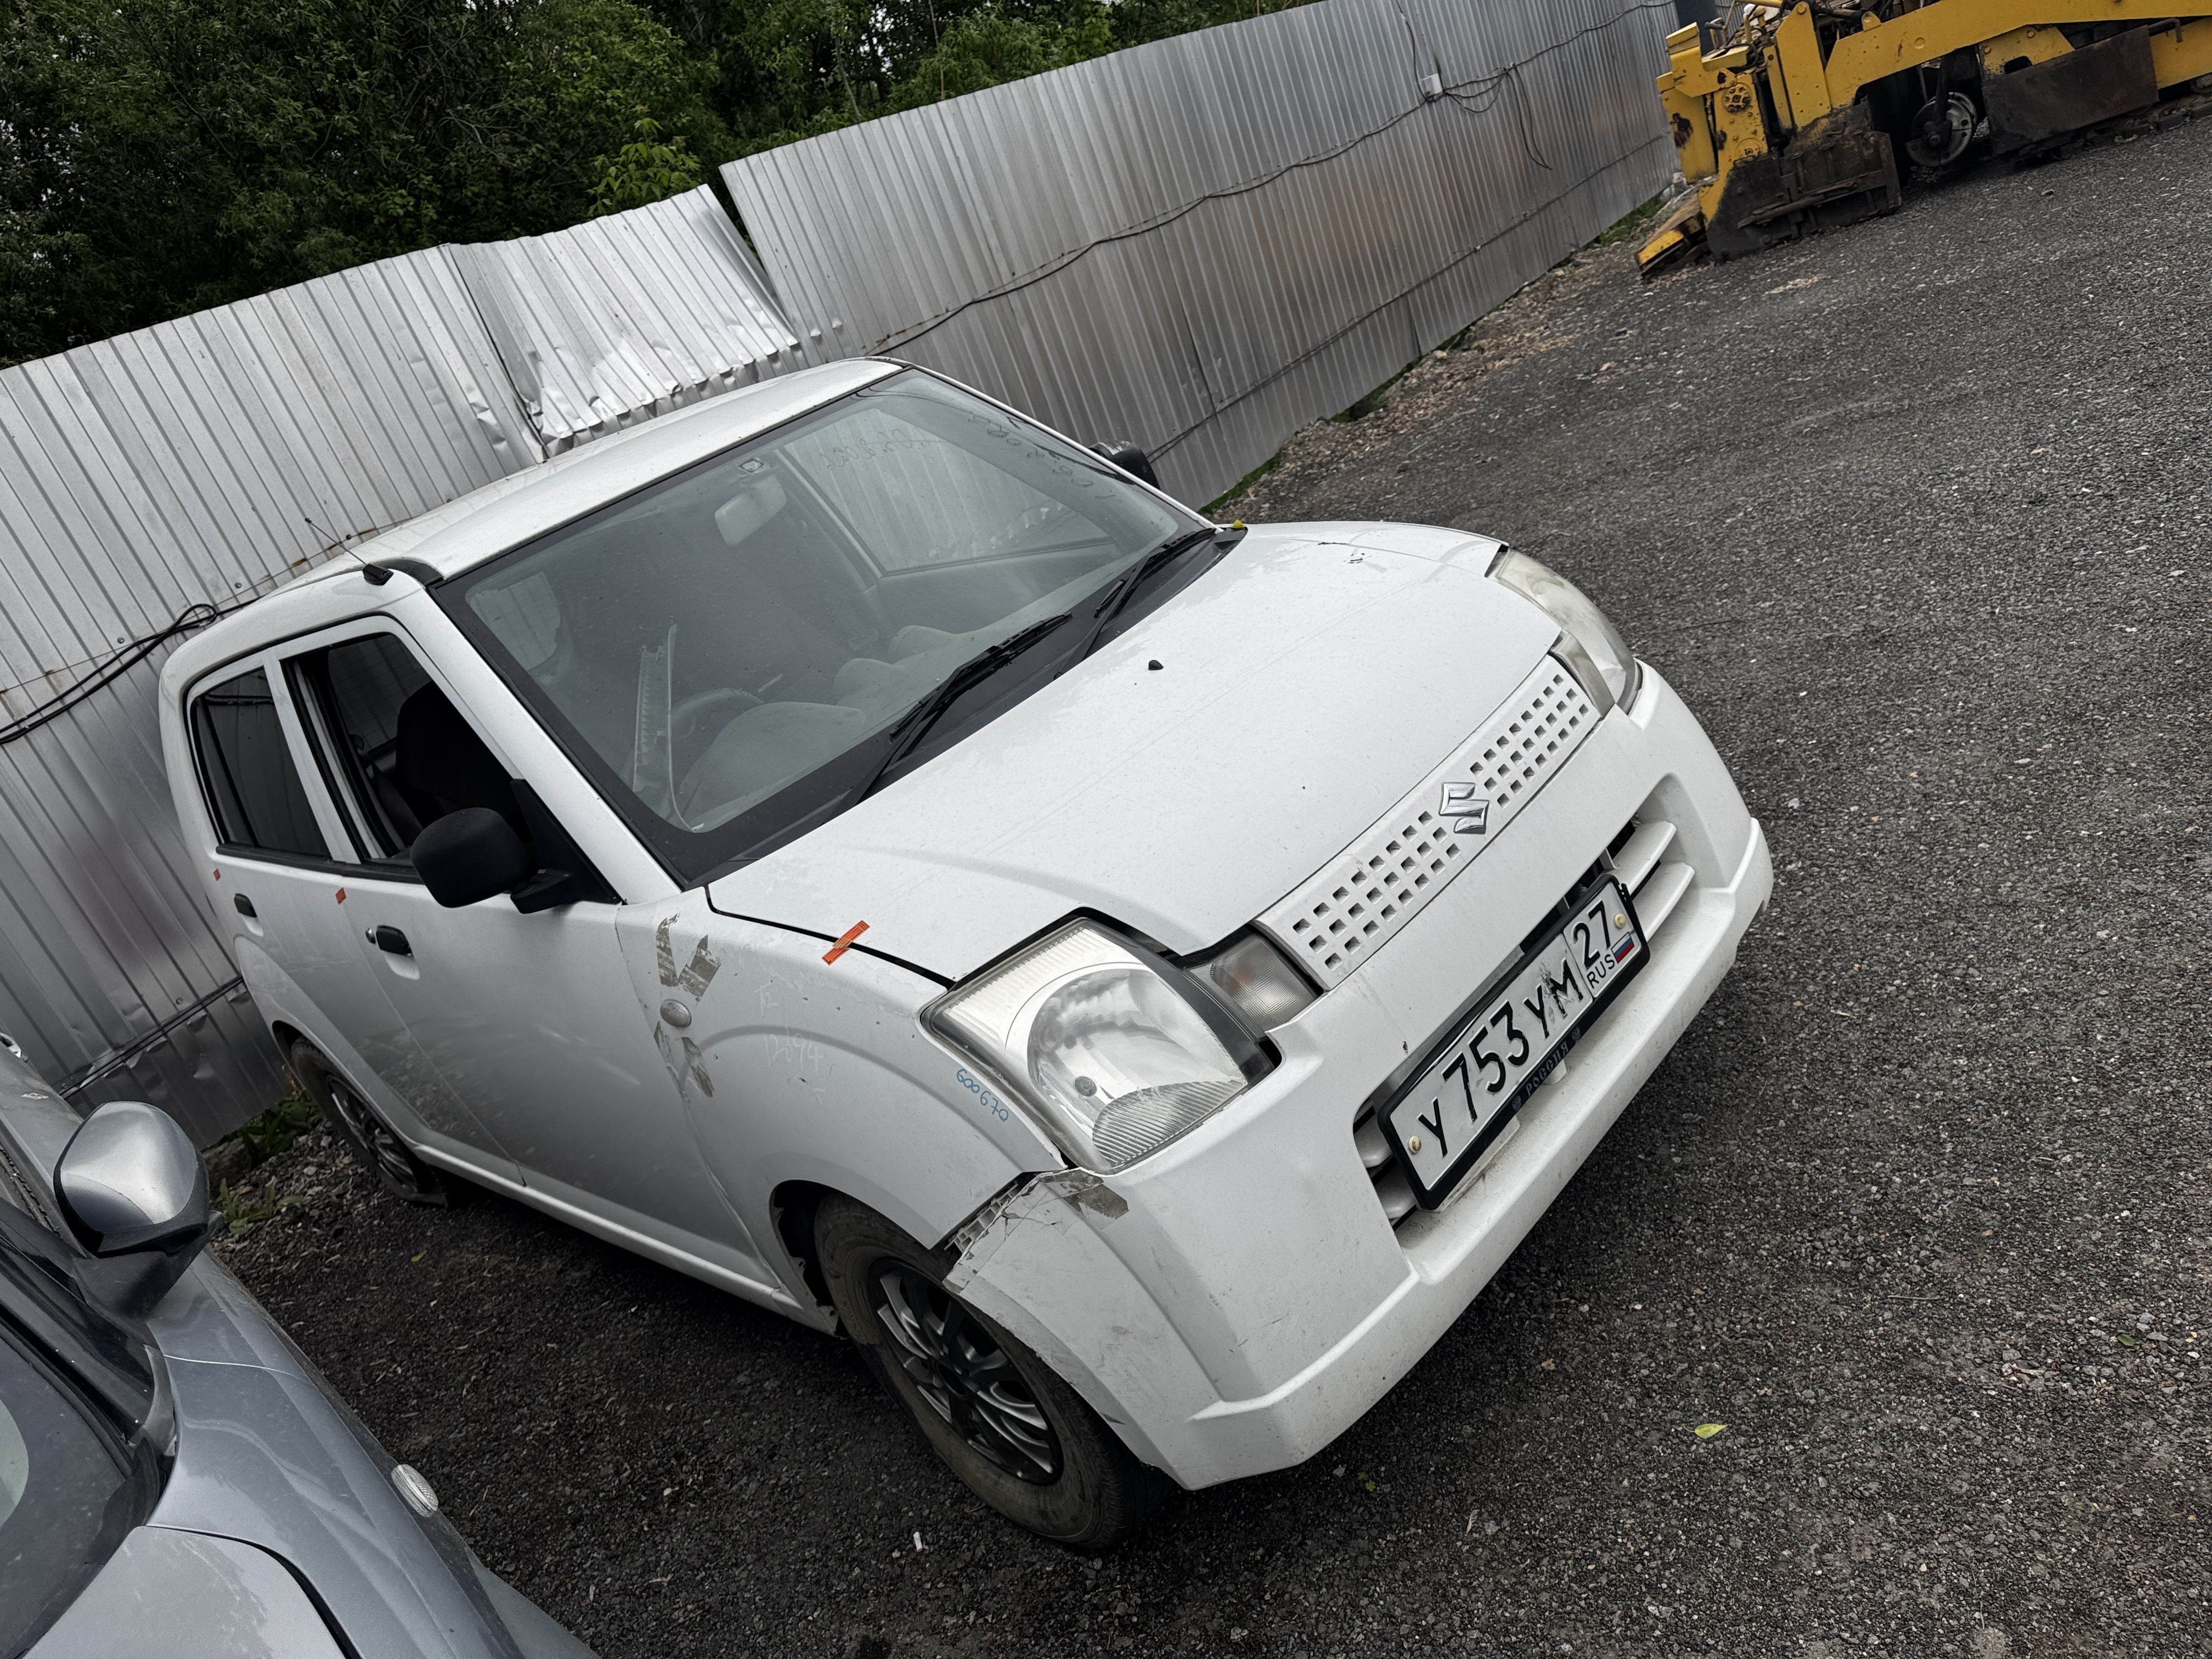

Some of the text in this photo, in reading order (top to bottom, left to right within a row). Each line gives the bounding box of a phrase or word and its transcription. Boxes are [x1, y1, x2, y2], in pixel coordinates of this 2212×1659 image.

[1572, 900, 1611, 970] 27
[1587, 953, 1615, 989] RUS
[956, 1068, 1009, 1122] 600670
[1525, 1041, 1569, 1097] РОССИЯ
